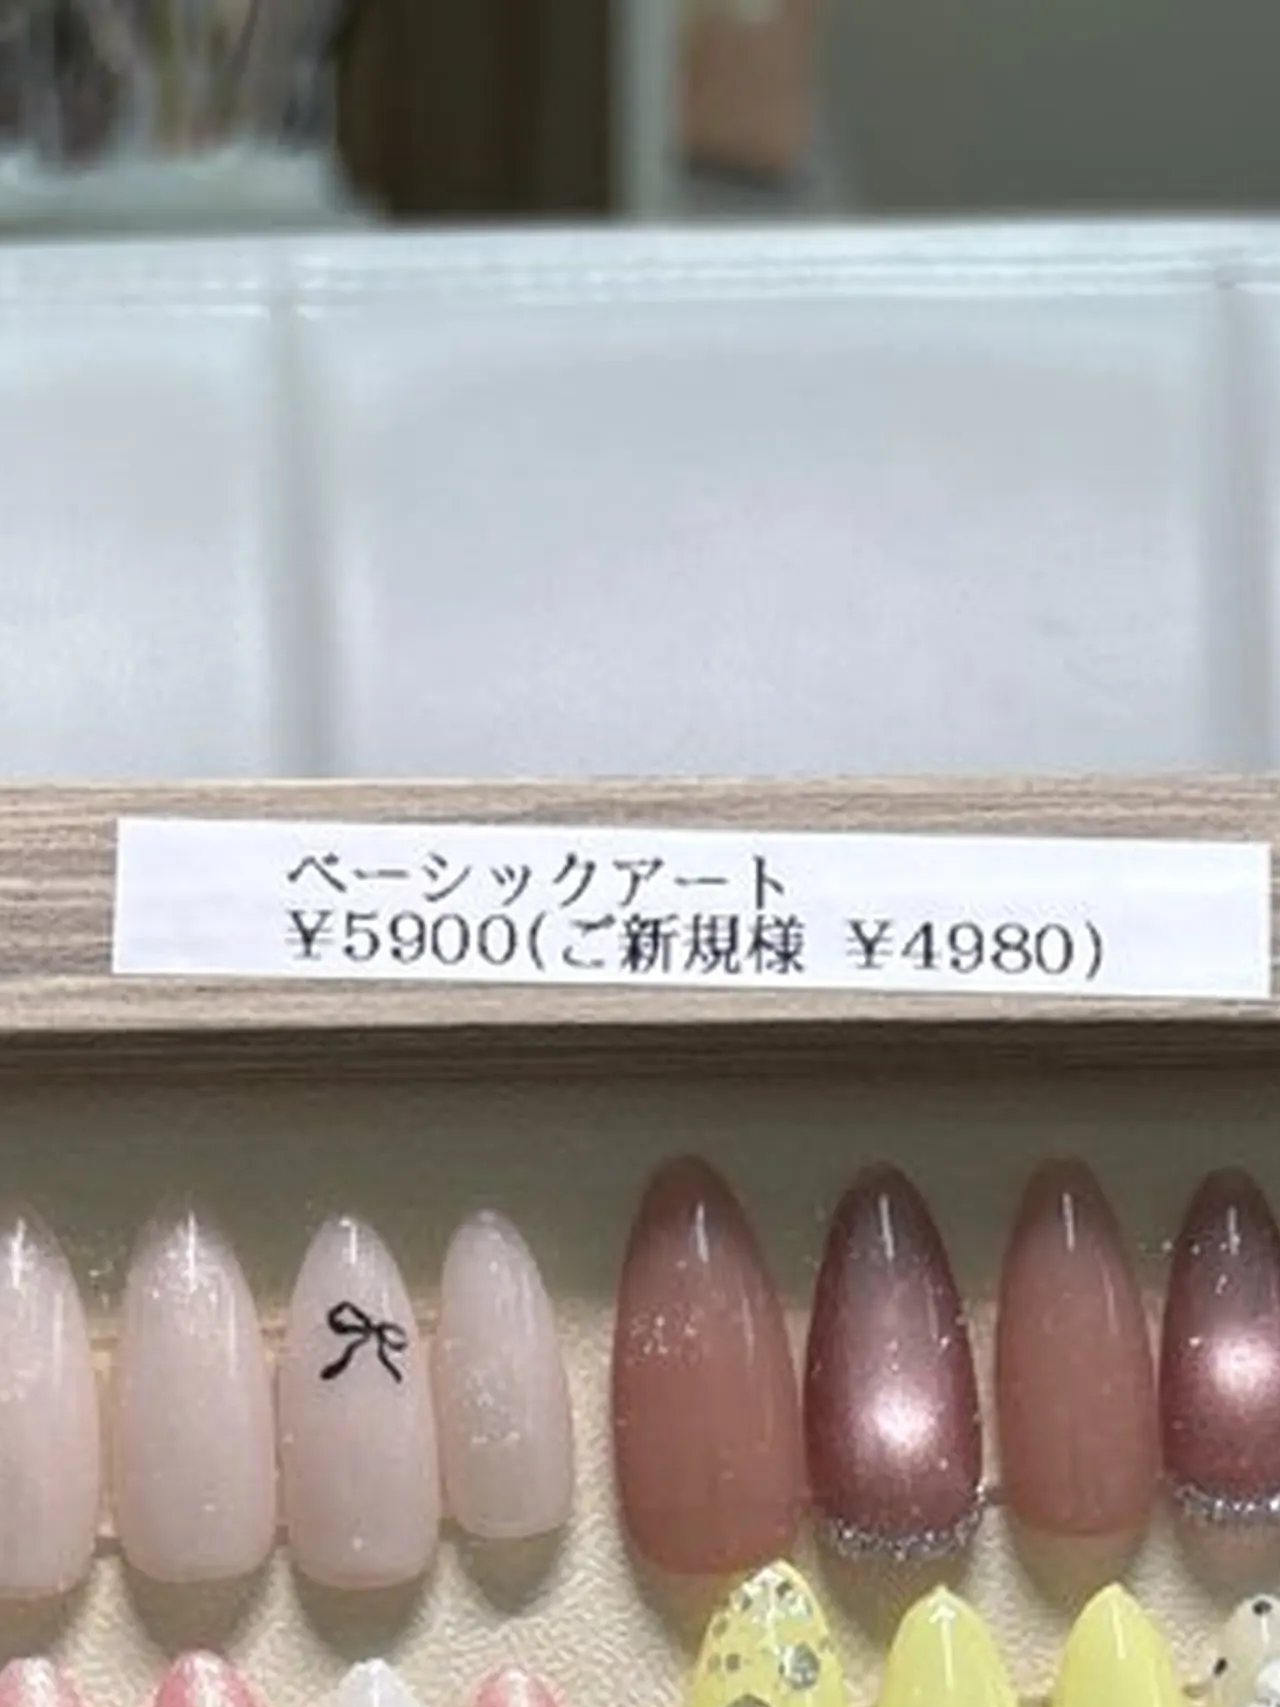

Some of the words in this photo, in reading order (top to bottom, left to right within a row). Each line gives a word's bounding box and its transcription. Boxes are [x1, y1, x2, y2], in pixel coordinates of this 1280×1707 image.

[287, 853, 785, 910] ベーシックアート
[284, 909, 805, 975] ¥5900(ご新規様
[846, 919, 1105, 980] ¥4980)
